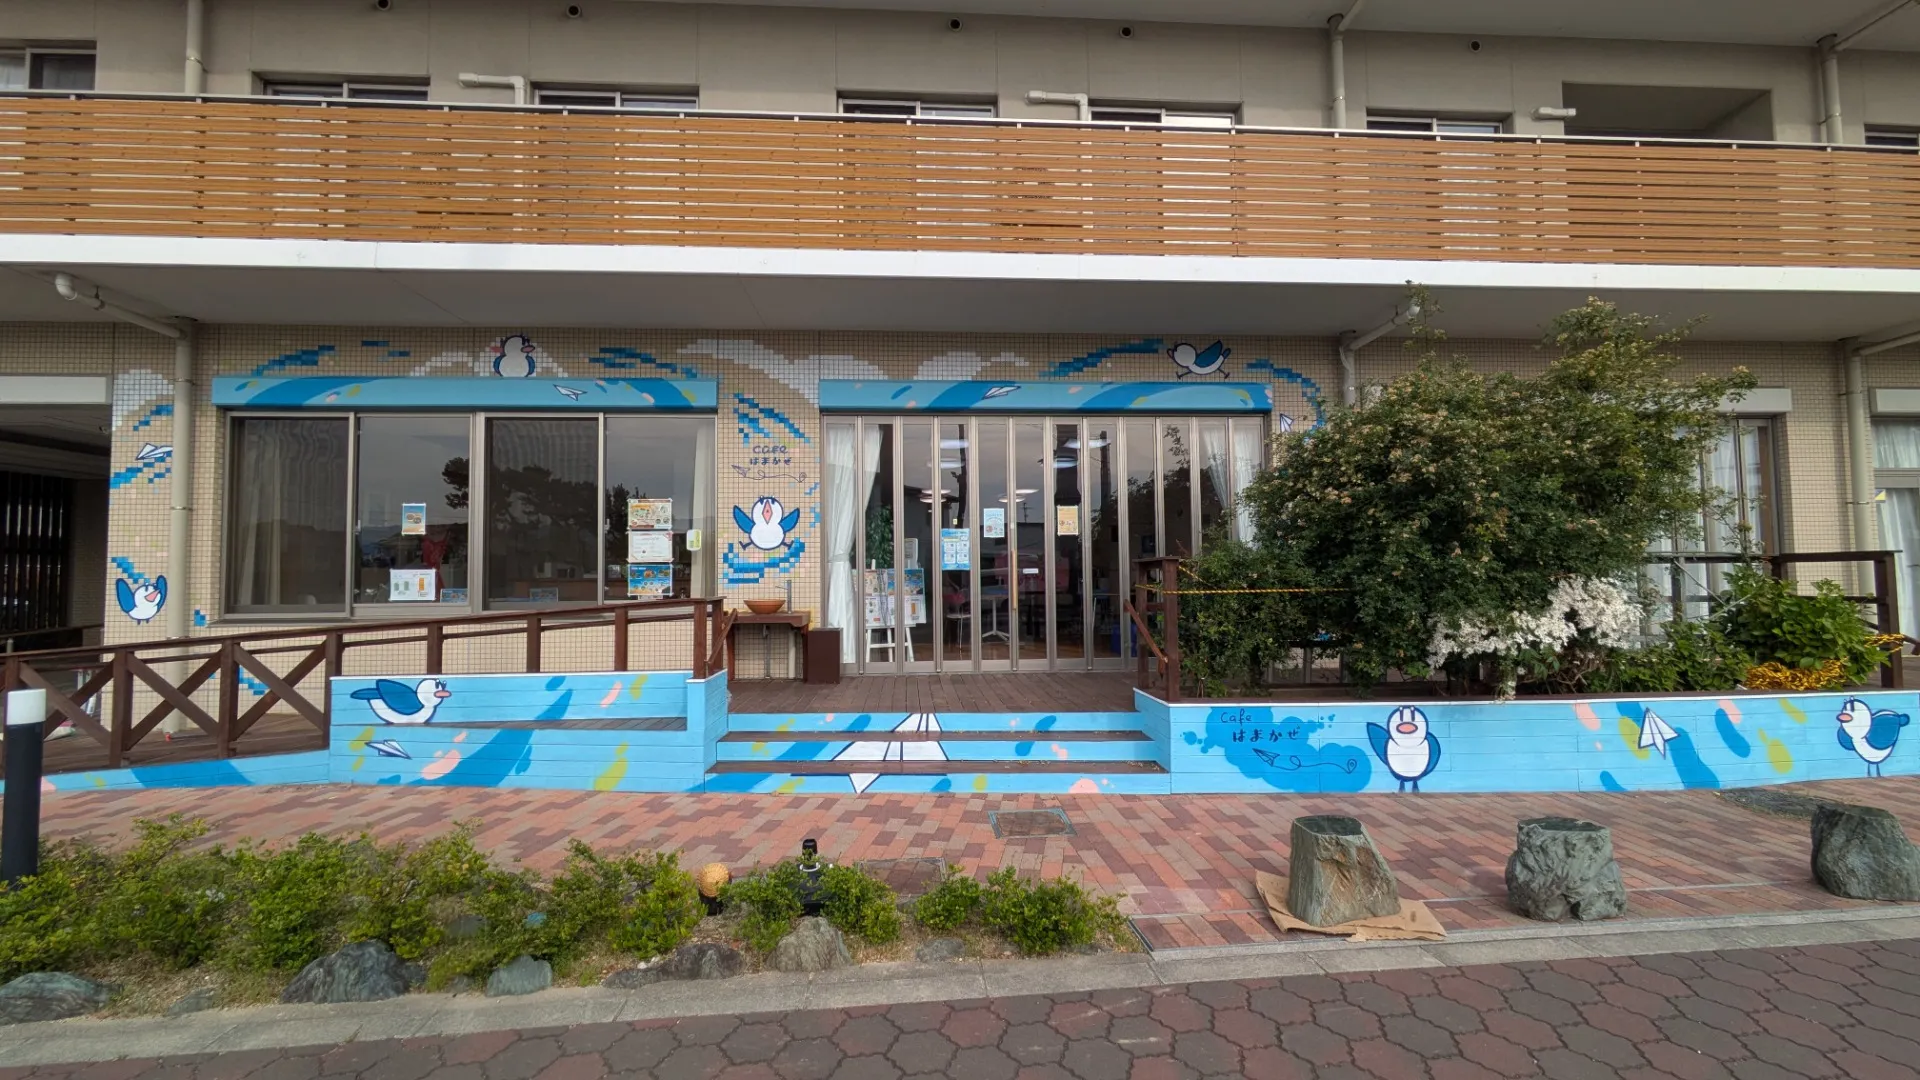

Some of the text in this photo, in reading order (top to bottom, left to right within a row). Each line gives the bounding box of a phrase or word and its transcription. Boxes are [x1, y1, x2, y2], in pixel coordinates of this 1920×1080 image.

[750, 457, 792, 466] はまかぜ
[1220, 708, 1252, 726] Cafe
[1232, 724, 1301, 743] はまかぜ
